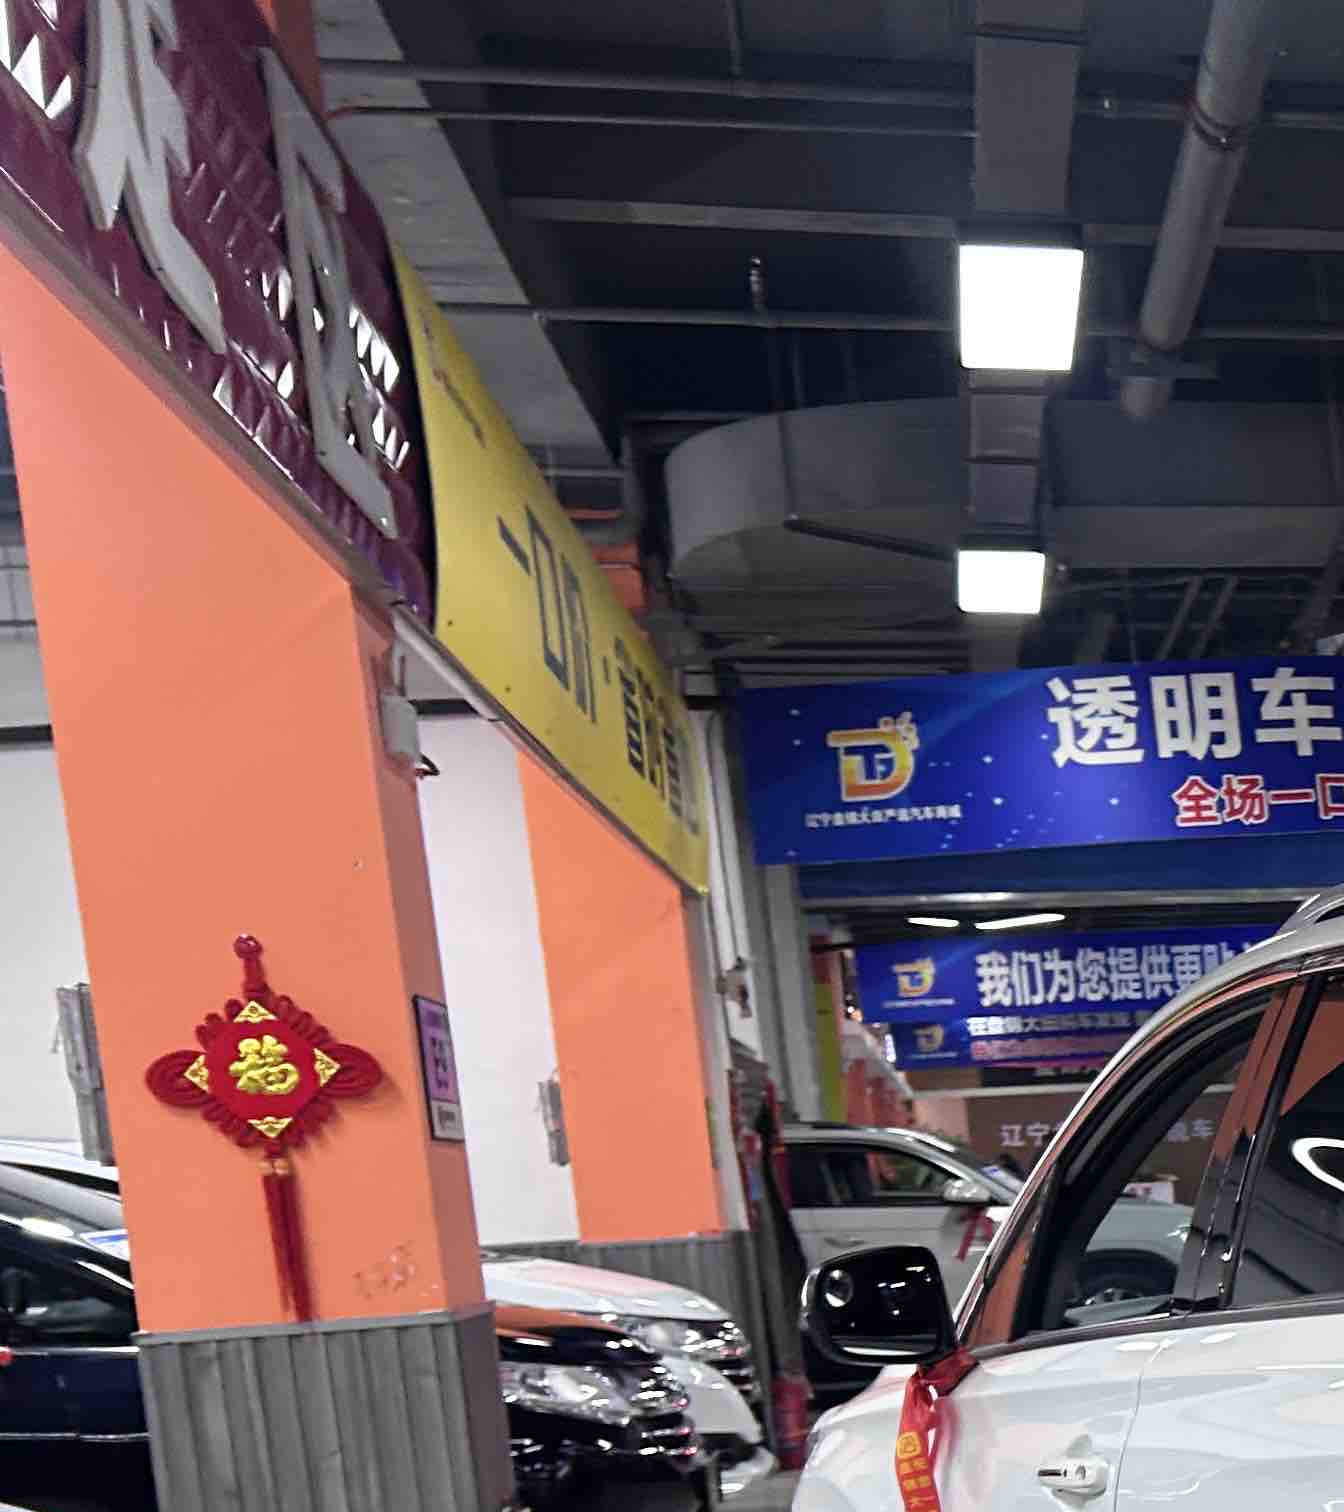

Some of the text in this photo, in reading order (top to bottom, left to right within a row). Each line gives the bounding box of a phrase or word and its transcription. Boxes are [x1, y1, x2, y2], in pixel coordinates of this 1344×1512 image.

[976, 943, 1251, 1008] 我们为您提供更
